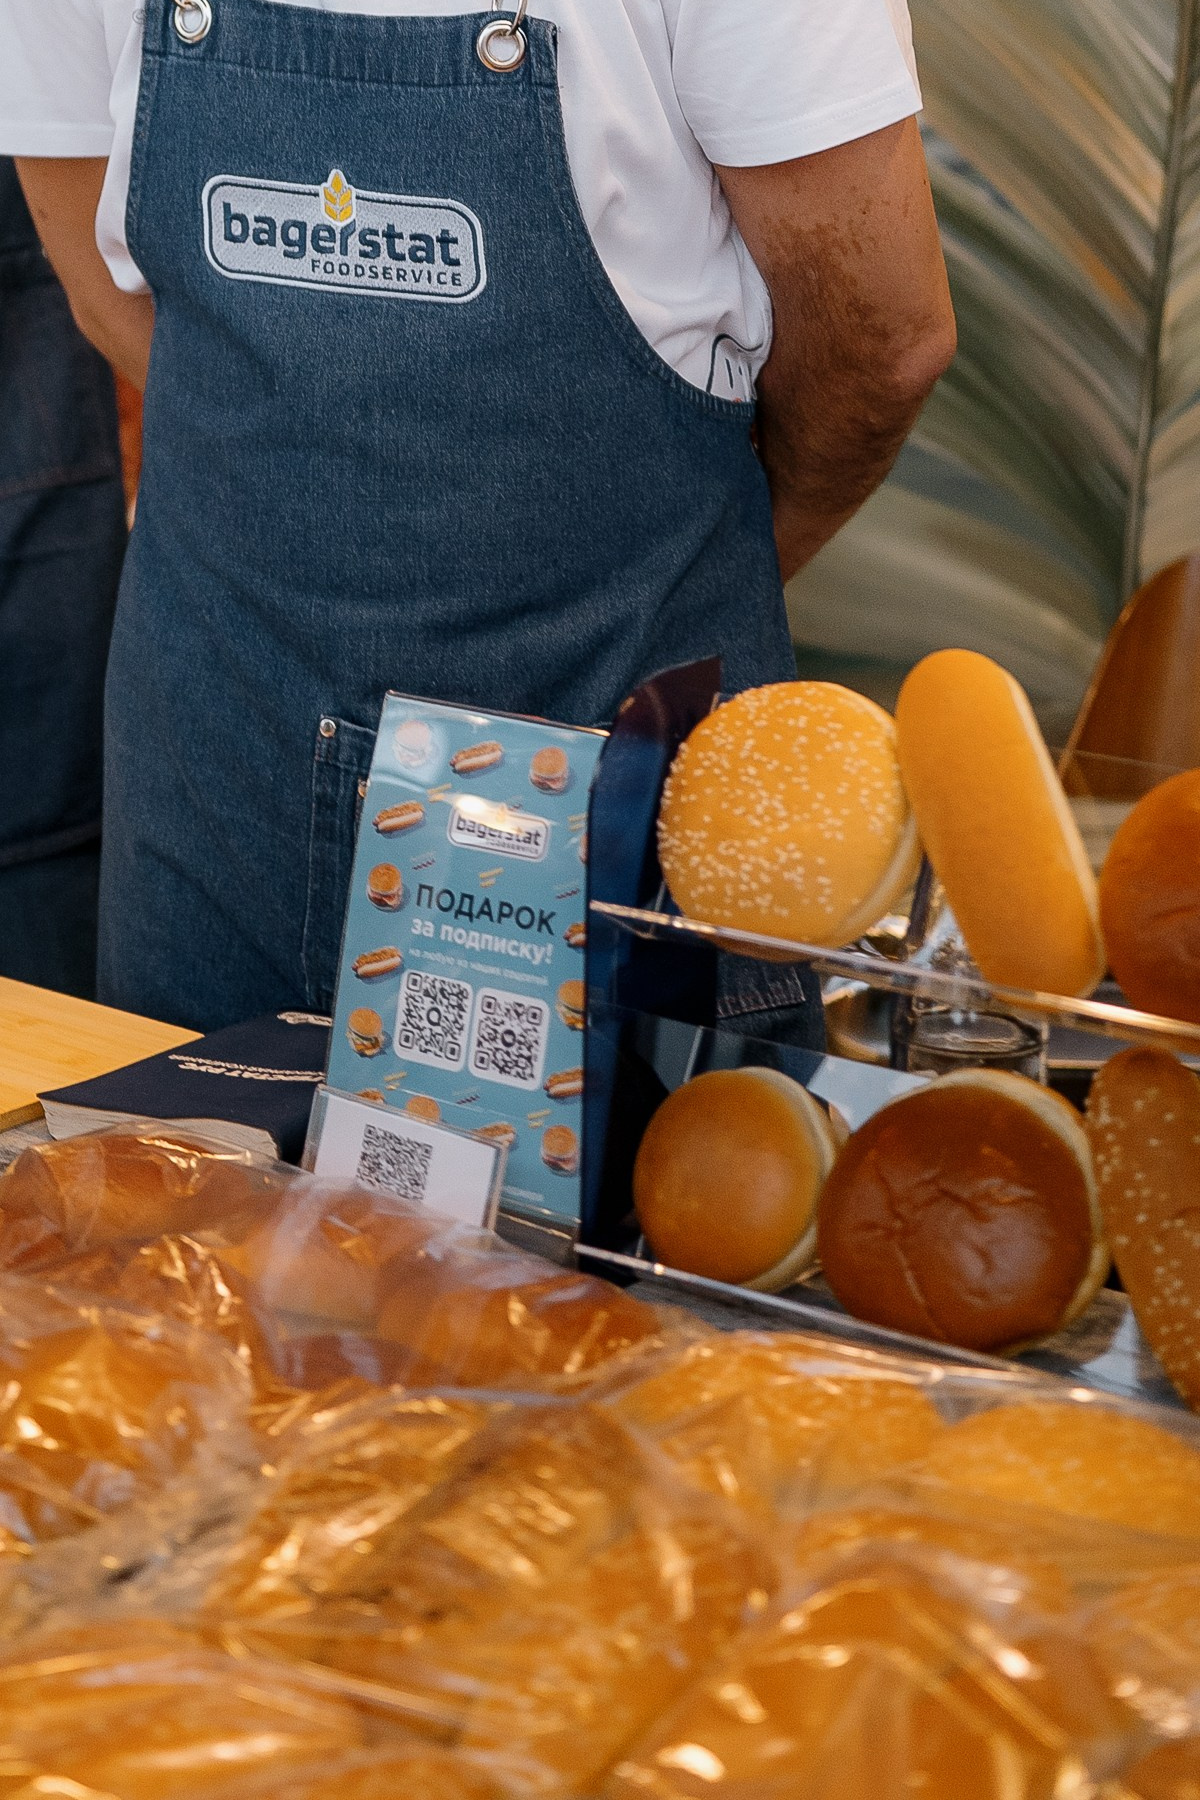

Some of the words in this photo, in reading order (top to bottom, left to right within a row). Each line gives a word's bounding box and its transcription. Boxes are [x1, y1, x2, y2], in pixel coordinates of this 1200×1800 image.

[222, 201, 462, 268] bagerstat
[310, 258, 463, 288] FOODSERVICE
[416, 883, 557, 937] ПОДАРОК
[410, 917, 435, 938] за
[439, 923, 555, 965] подписку!
